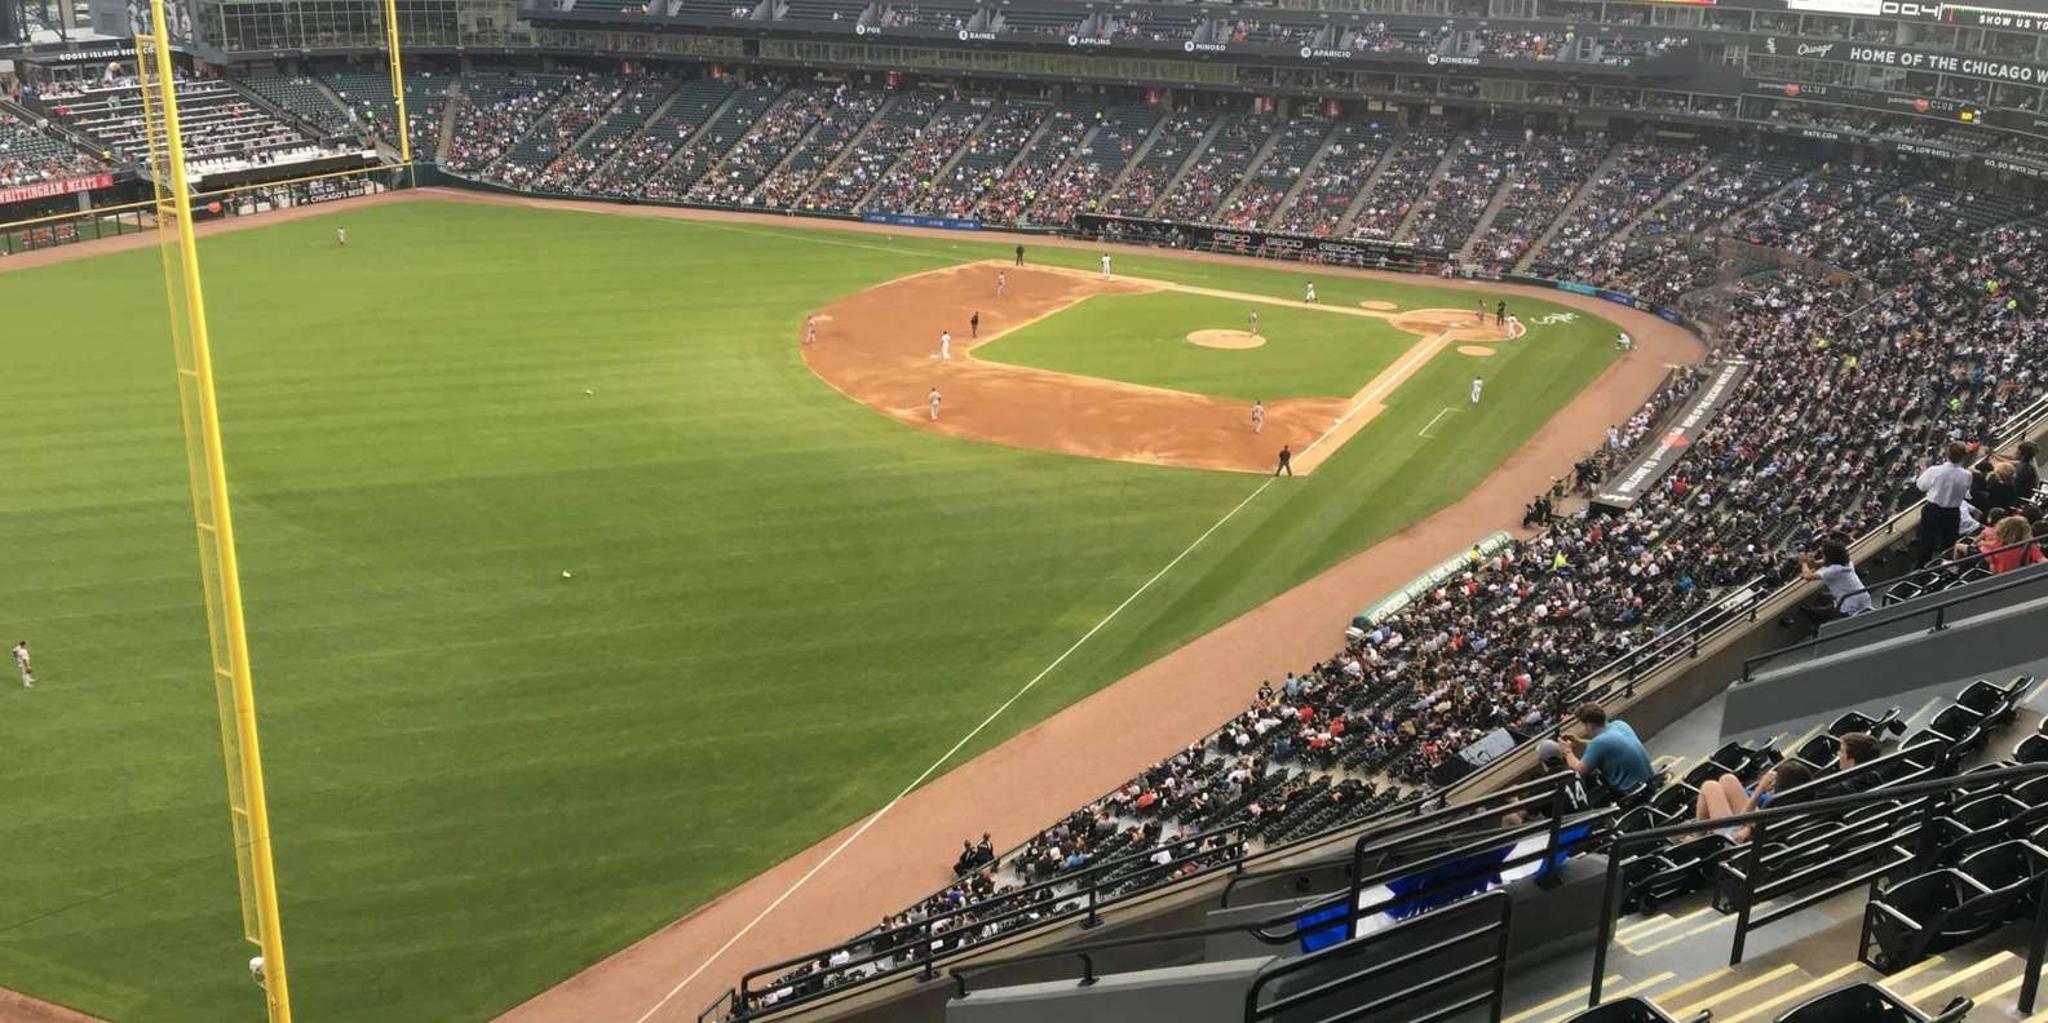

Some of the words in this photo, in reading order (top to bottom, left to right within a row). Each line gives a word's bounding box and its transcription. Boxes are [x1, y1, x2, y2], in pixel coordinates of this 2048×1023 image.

[1979, 15, 2011, 26] SHOW
[2017, 19, 2031, 28] US
[1850, 47, 1896, 64] HOME
[1901, 52, 1924, 66] OF
[1929, 55, 1958, 71] THE
[1962, 60, 2032, 81] CHICAGO
